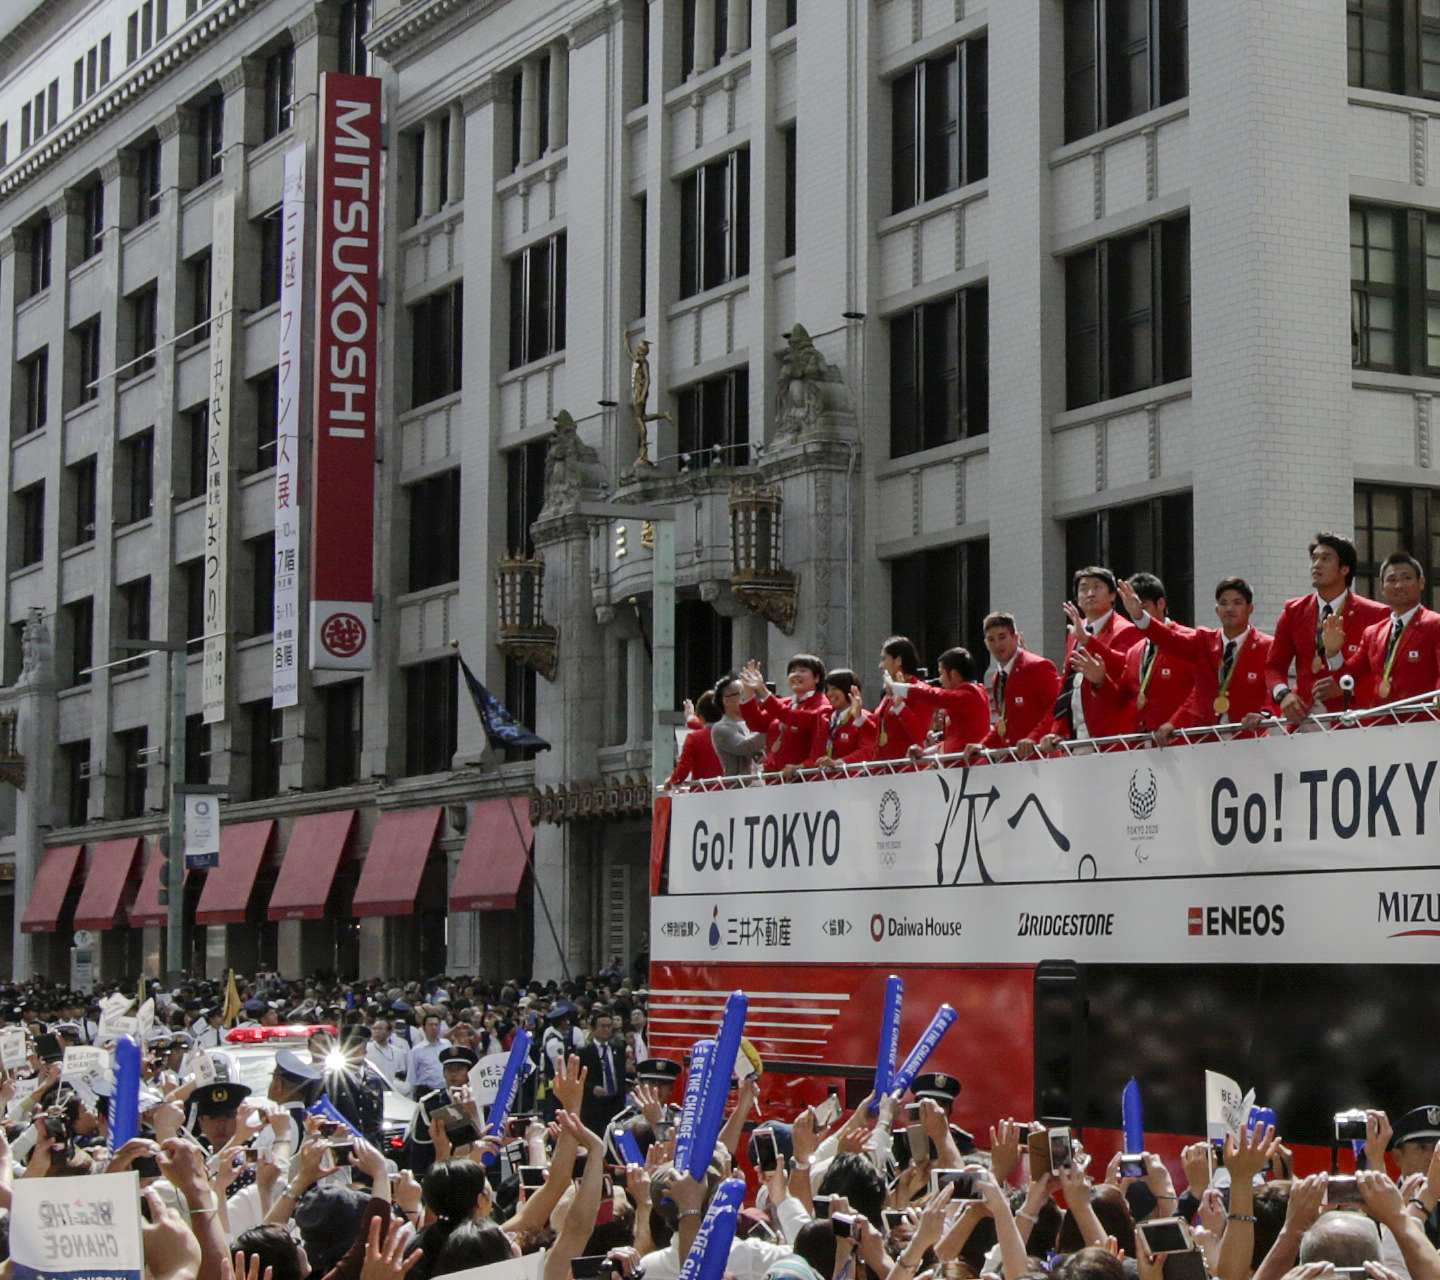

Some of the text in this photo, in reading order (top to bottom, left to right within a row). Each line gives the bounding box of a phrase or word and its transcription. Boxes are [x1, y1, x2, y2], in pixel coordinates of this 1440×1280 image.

[329, 100, 372, 438] MITSUKOSHI
[935, 769, 1097, 886] 次へ。
[1127, 824, 1159, 836] TOKYO 2020
[1211, 773, 1283, 846] Go!
[692, 809, 841, 872] Go! TOKYO
[727, 916, 791, 947] 三井不動産
[1018, 911, 1114, 937] BRIDGESTONE
[1206, 904, 1285, 937] ENEOS
[480, 1066, 493, 1079] BE
[905, 1018, 948, 1077] BE THE CHANGE
[678, 1056, 705, 1140] BE THE CHANGE
